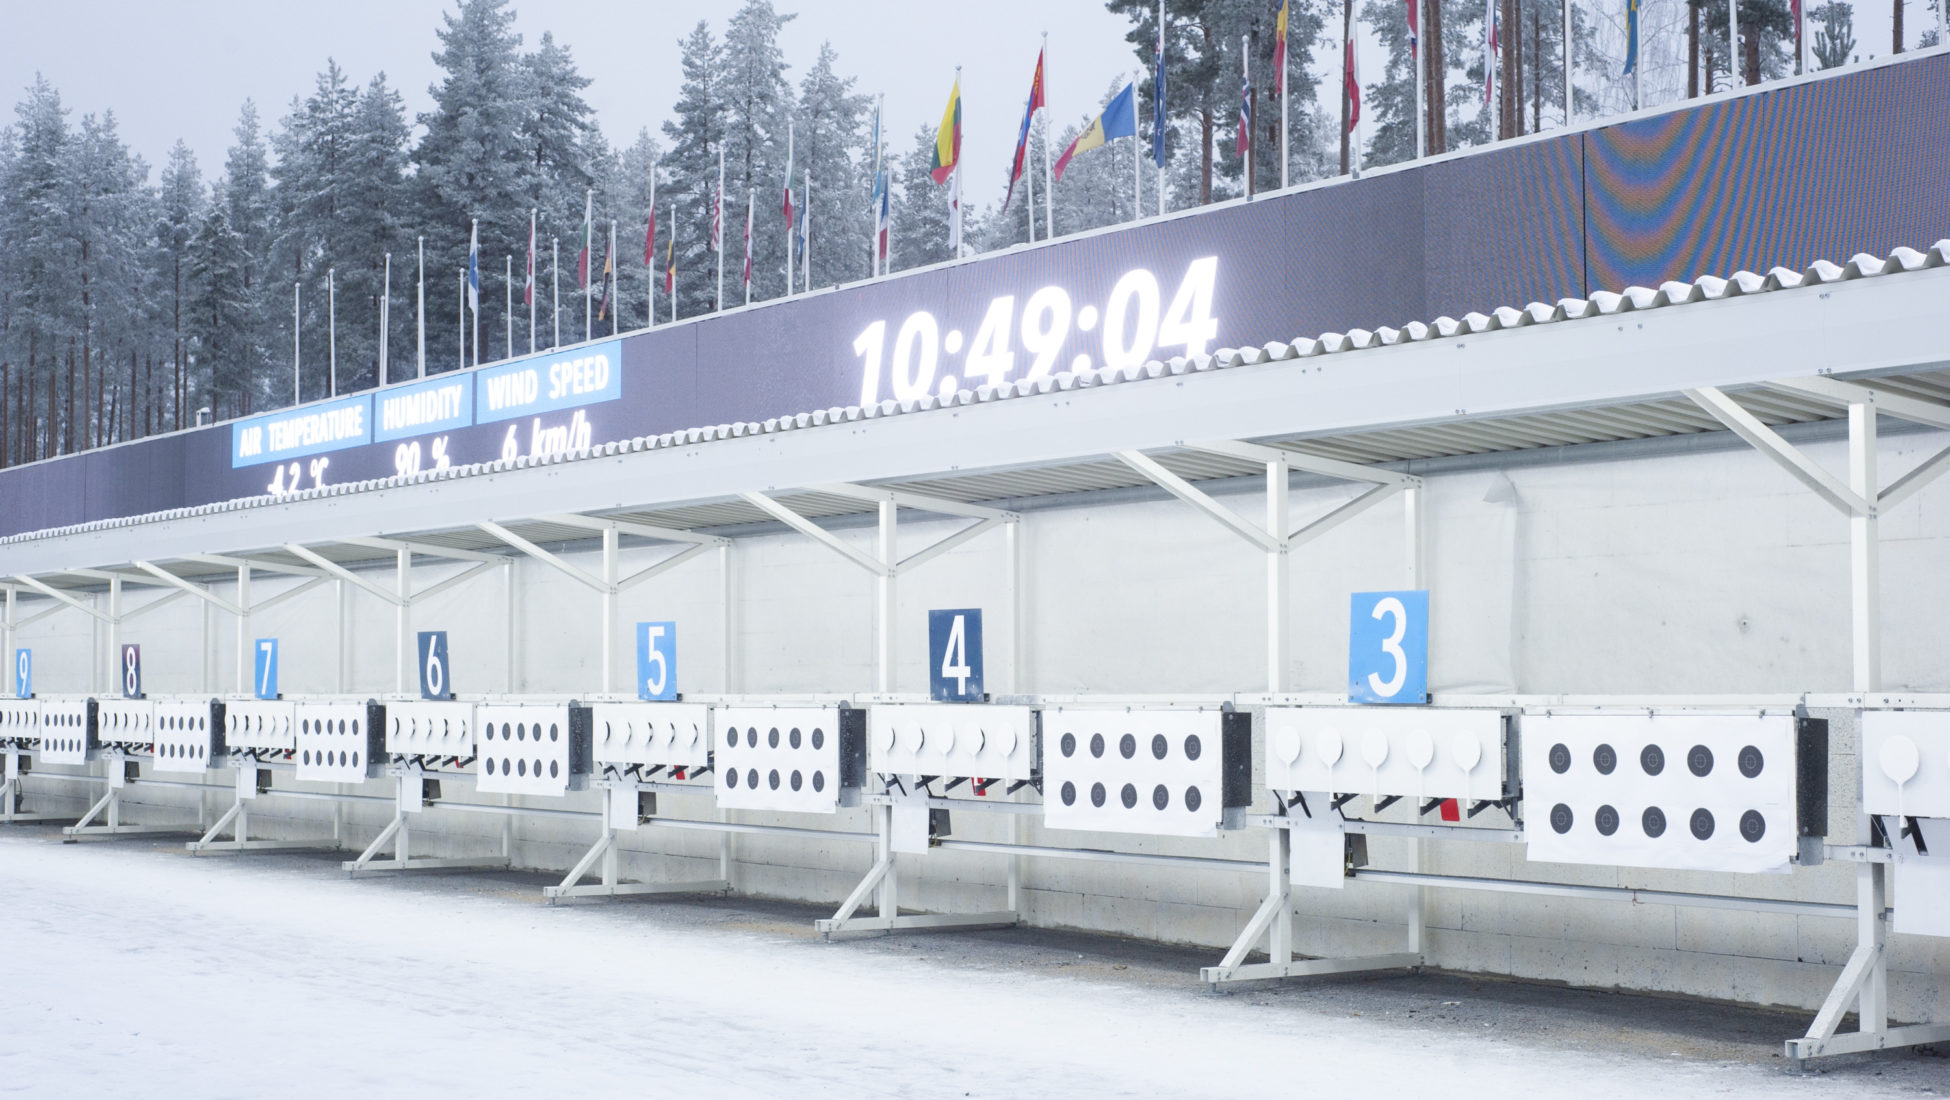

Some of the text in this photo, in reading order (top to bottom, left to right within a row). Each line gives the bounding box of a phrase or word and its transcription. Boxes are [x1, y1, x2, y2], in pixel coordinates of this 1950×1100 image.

[852, 256, 1218, 406] 10:49:04
[384, 384, 463, 430] HUMIDITY
[488, 354, 609, 411] WIND SPEED
[239, 405, 363, 458] AIR TEMPERATURE
[395, 435, 450, 478] 90 %
[502, 409, 592, 464] 6 km/h
[19, 651, 28, 695] 9
[126, 646, 137, 696] 8
[260, 642, 273, 695] 7
[426, 635, 443, 696] 6
[647, 626, 667, 695] 5
[942, 615, 971, 695] 4
[1367, 597, 1408, 697] 3
